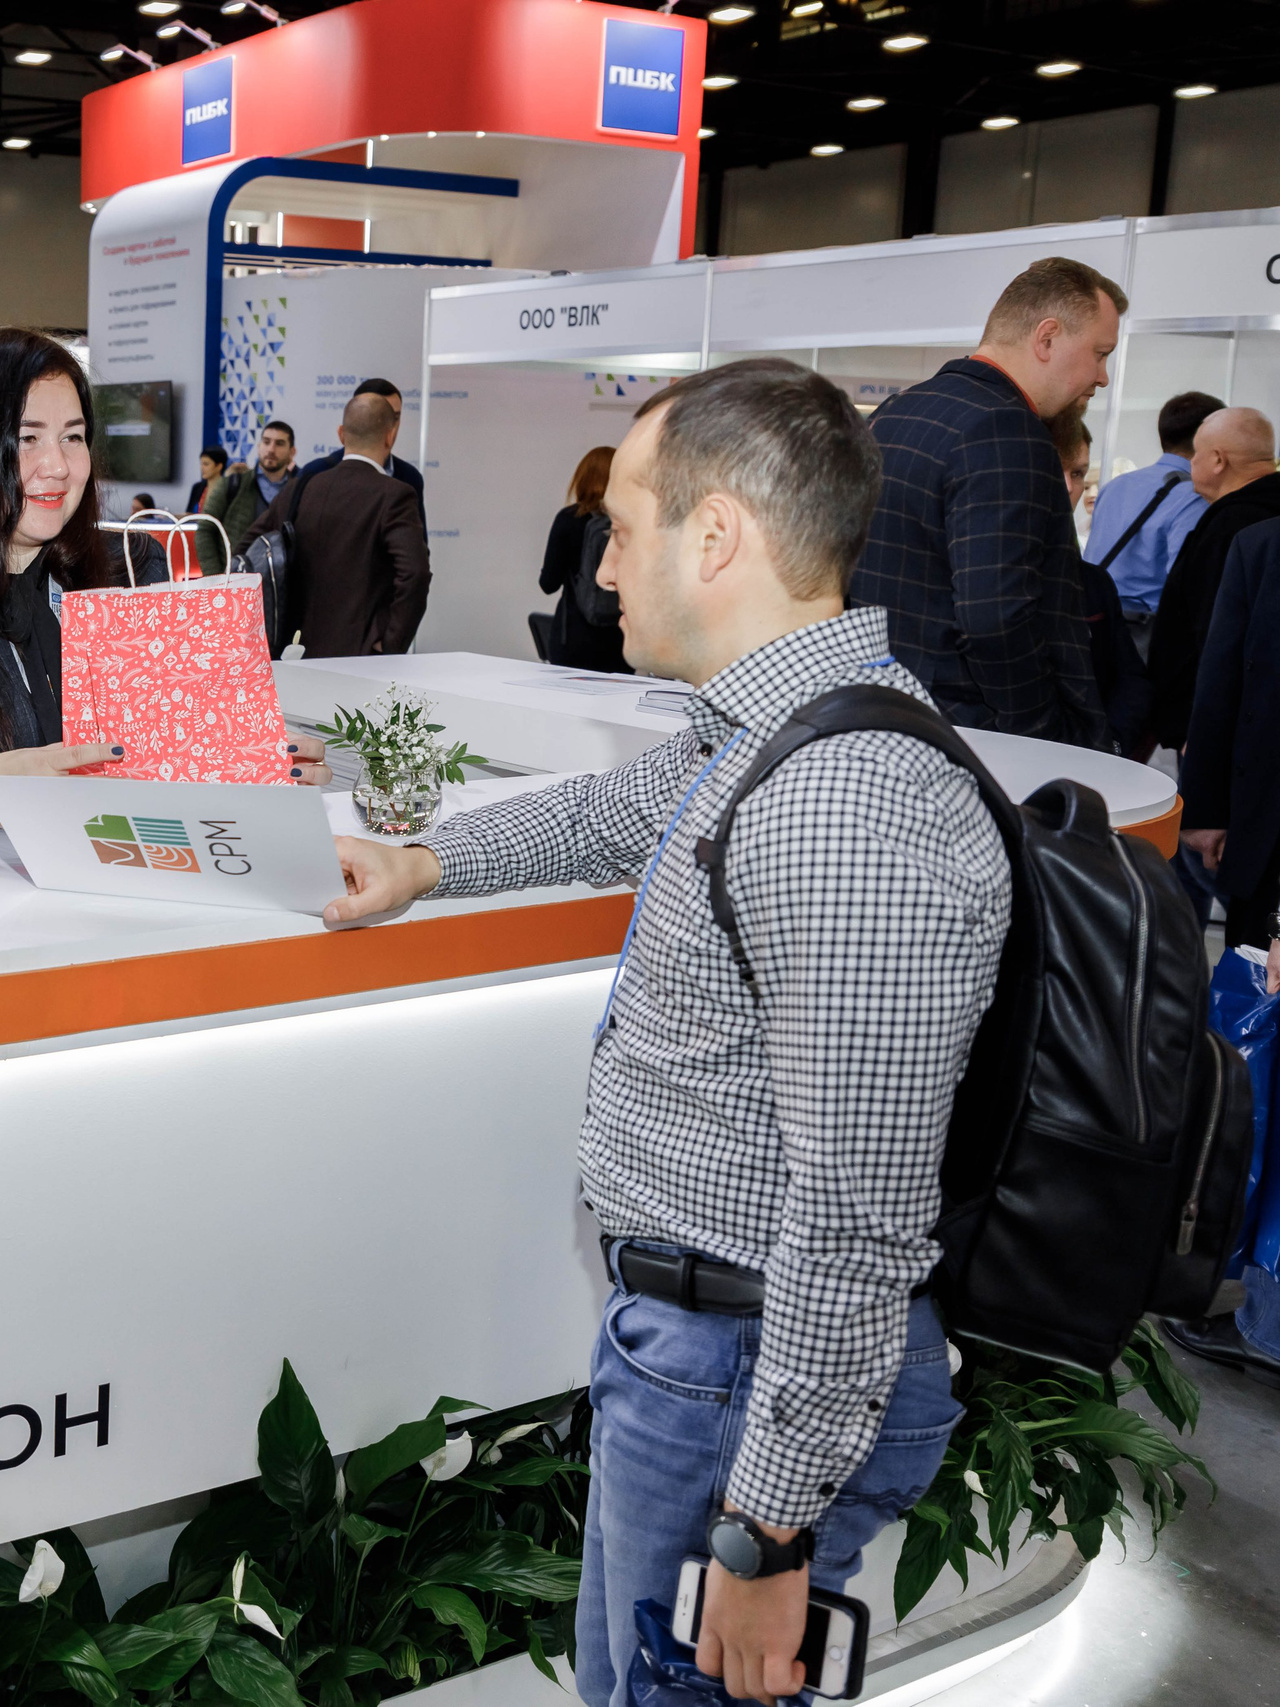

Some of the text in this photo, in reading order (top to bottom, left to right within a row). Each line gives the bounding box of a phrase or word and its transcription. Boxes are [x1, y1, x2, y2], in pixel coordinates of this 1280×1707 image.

[609, 65, 676, 92] ПЦБК
[185, 98, 229, 126] ПЦБК
[520, 303, 609, 330] ООО "ВЛК"
